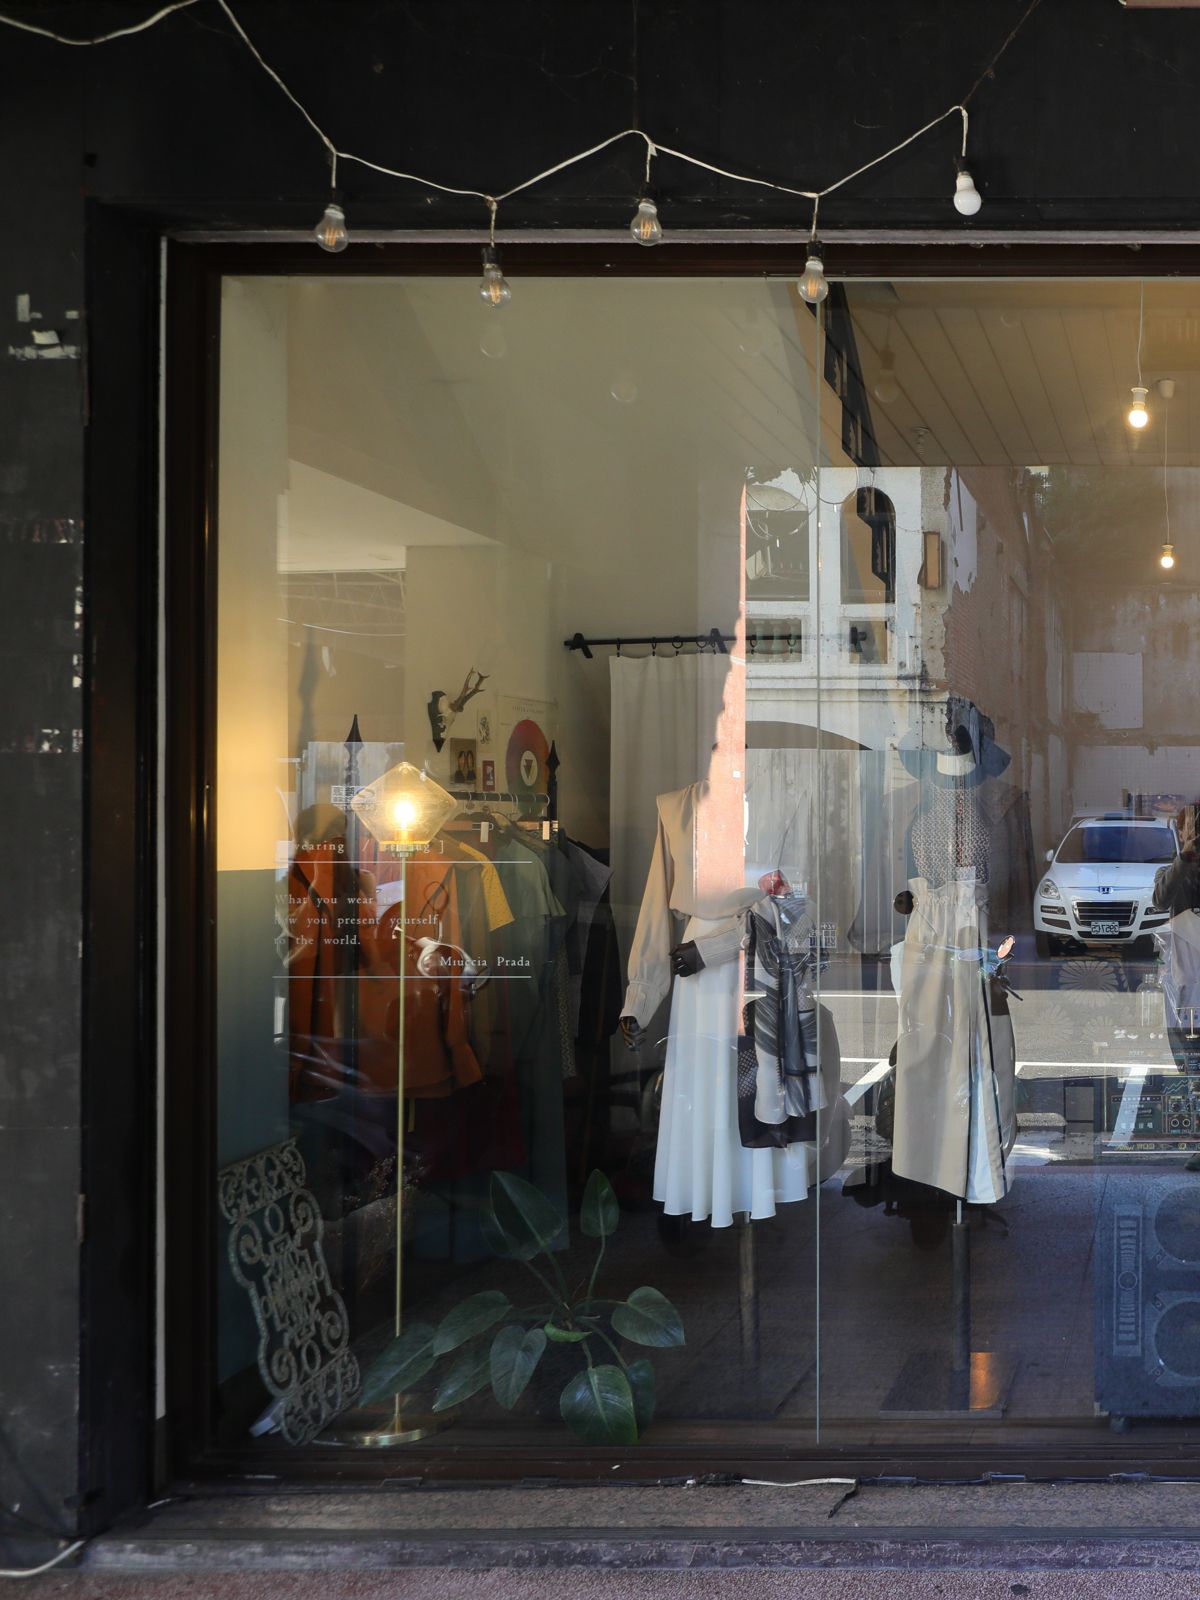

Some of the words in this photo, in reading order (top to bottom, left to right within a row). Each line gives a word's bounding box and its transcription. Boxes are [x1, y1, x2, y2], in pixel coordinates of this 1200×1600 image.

[274, 894, 308, 905] What
[316, 897, 338, 908] you
[347, 896, 374, 904] wear
[306, 917, 328, 928] you
[337, 916, 381, 928] present
[389, 913, 439, 928] yourself
[295, 934, 314, 945] the
[323, 934, 361, 945] world.
[439, 955, 488, 967] Miuccia
[496, 955, 531, 967] Prada
